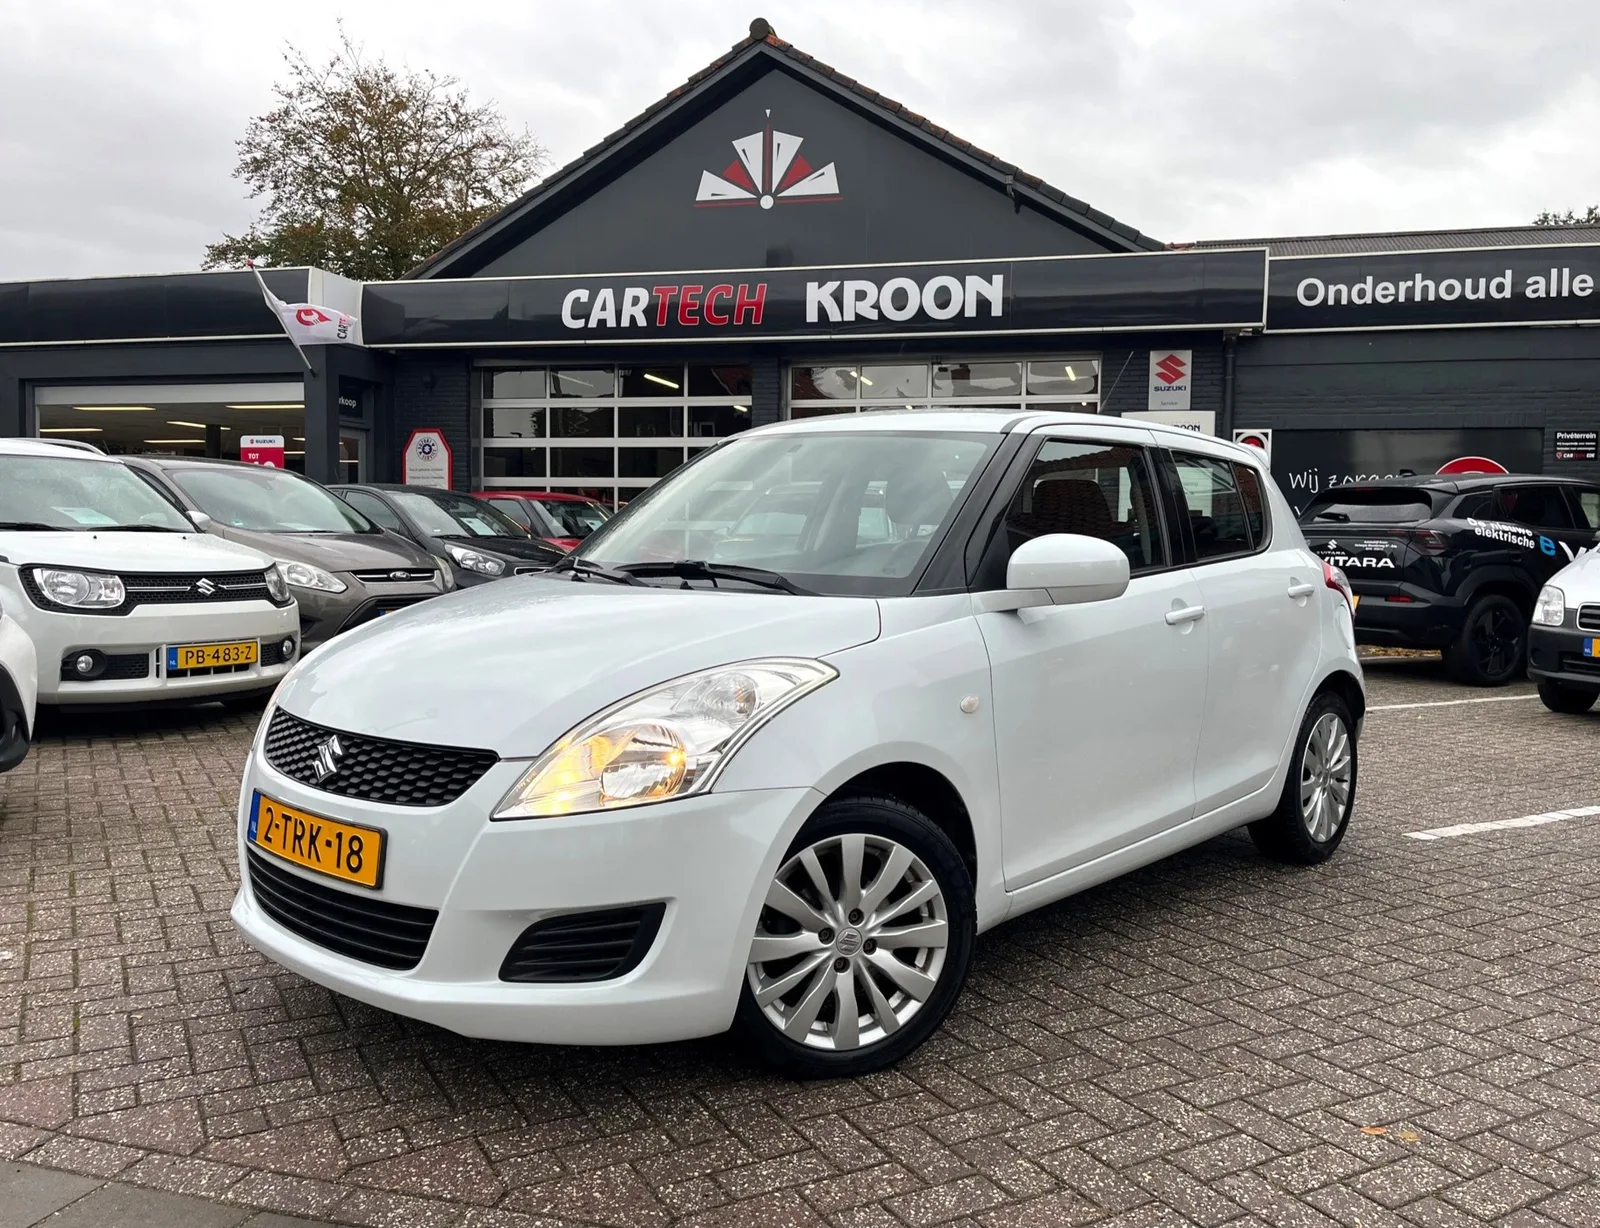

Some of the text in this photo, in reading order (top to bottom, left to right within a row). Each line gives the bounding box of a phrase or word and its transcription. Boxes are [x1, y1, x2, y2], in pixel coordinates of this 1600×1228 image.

[1296, 267, 1594, 307] Onderhoud alle
[561, 274, 1004, 329] CARTECH KROON
[1288, 467, 1319, 493] Wij
[1474, 526, 1535, 549] elektrische
[1490, 522, 1533, 537] nieuwe
[185, 646, 252, 665] PB-483-Z
[263, 806, 364, 874] 2-TRK-18
